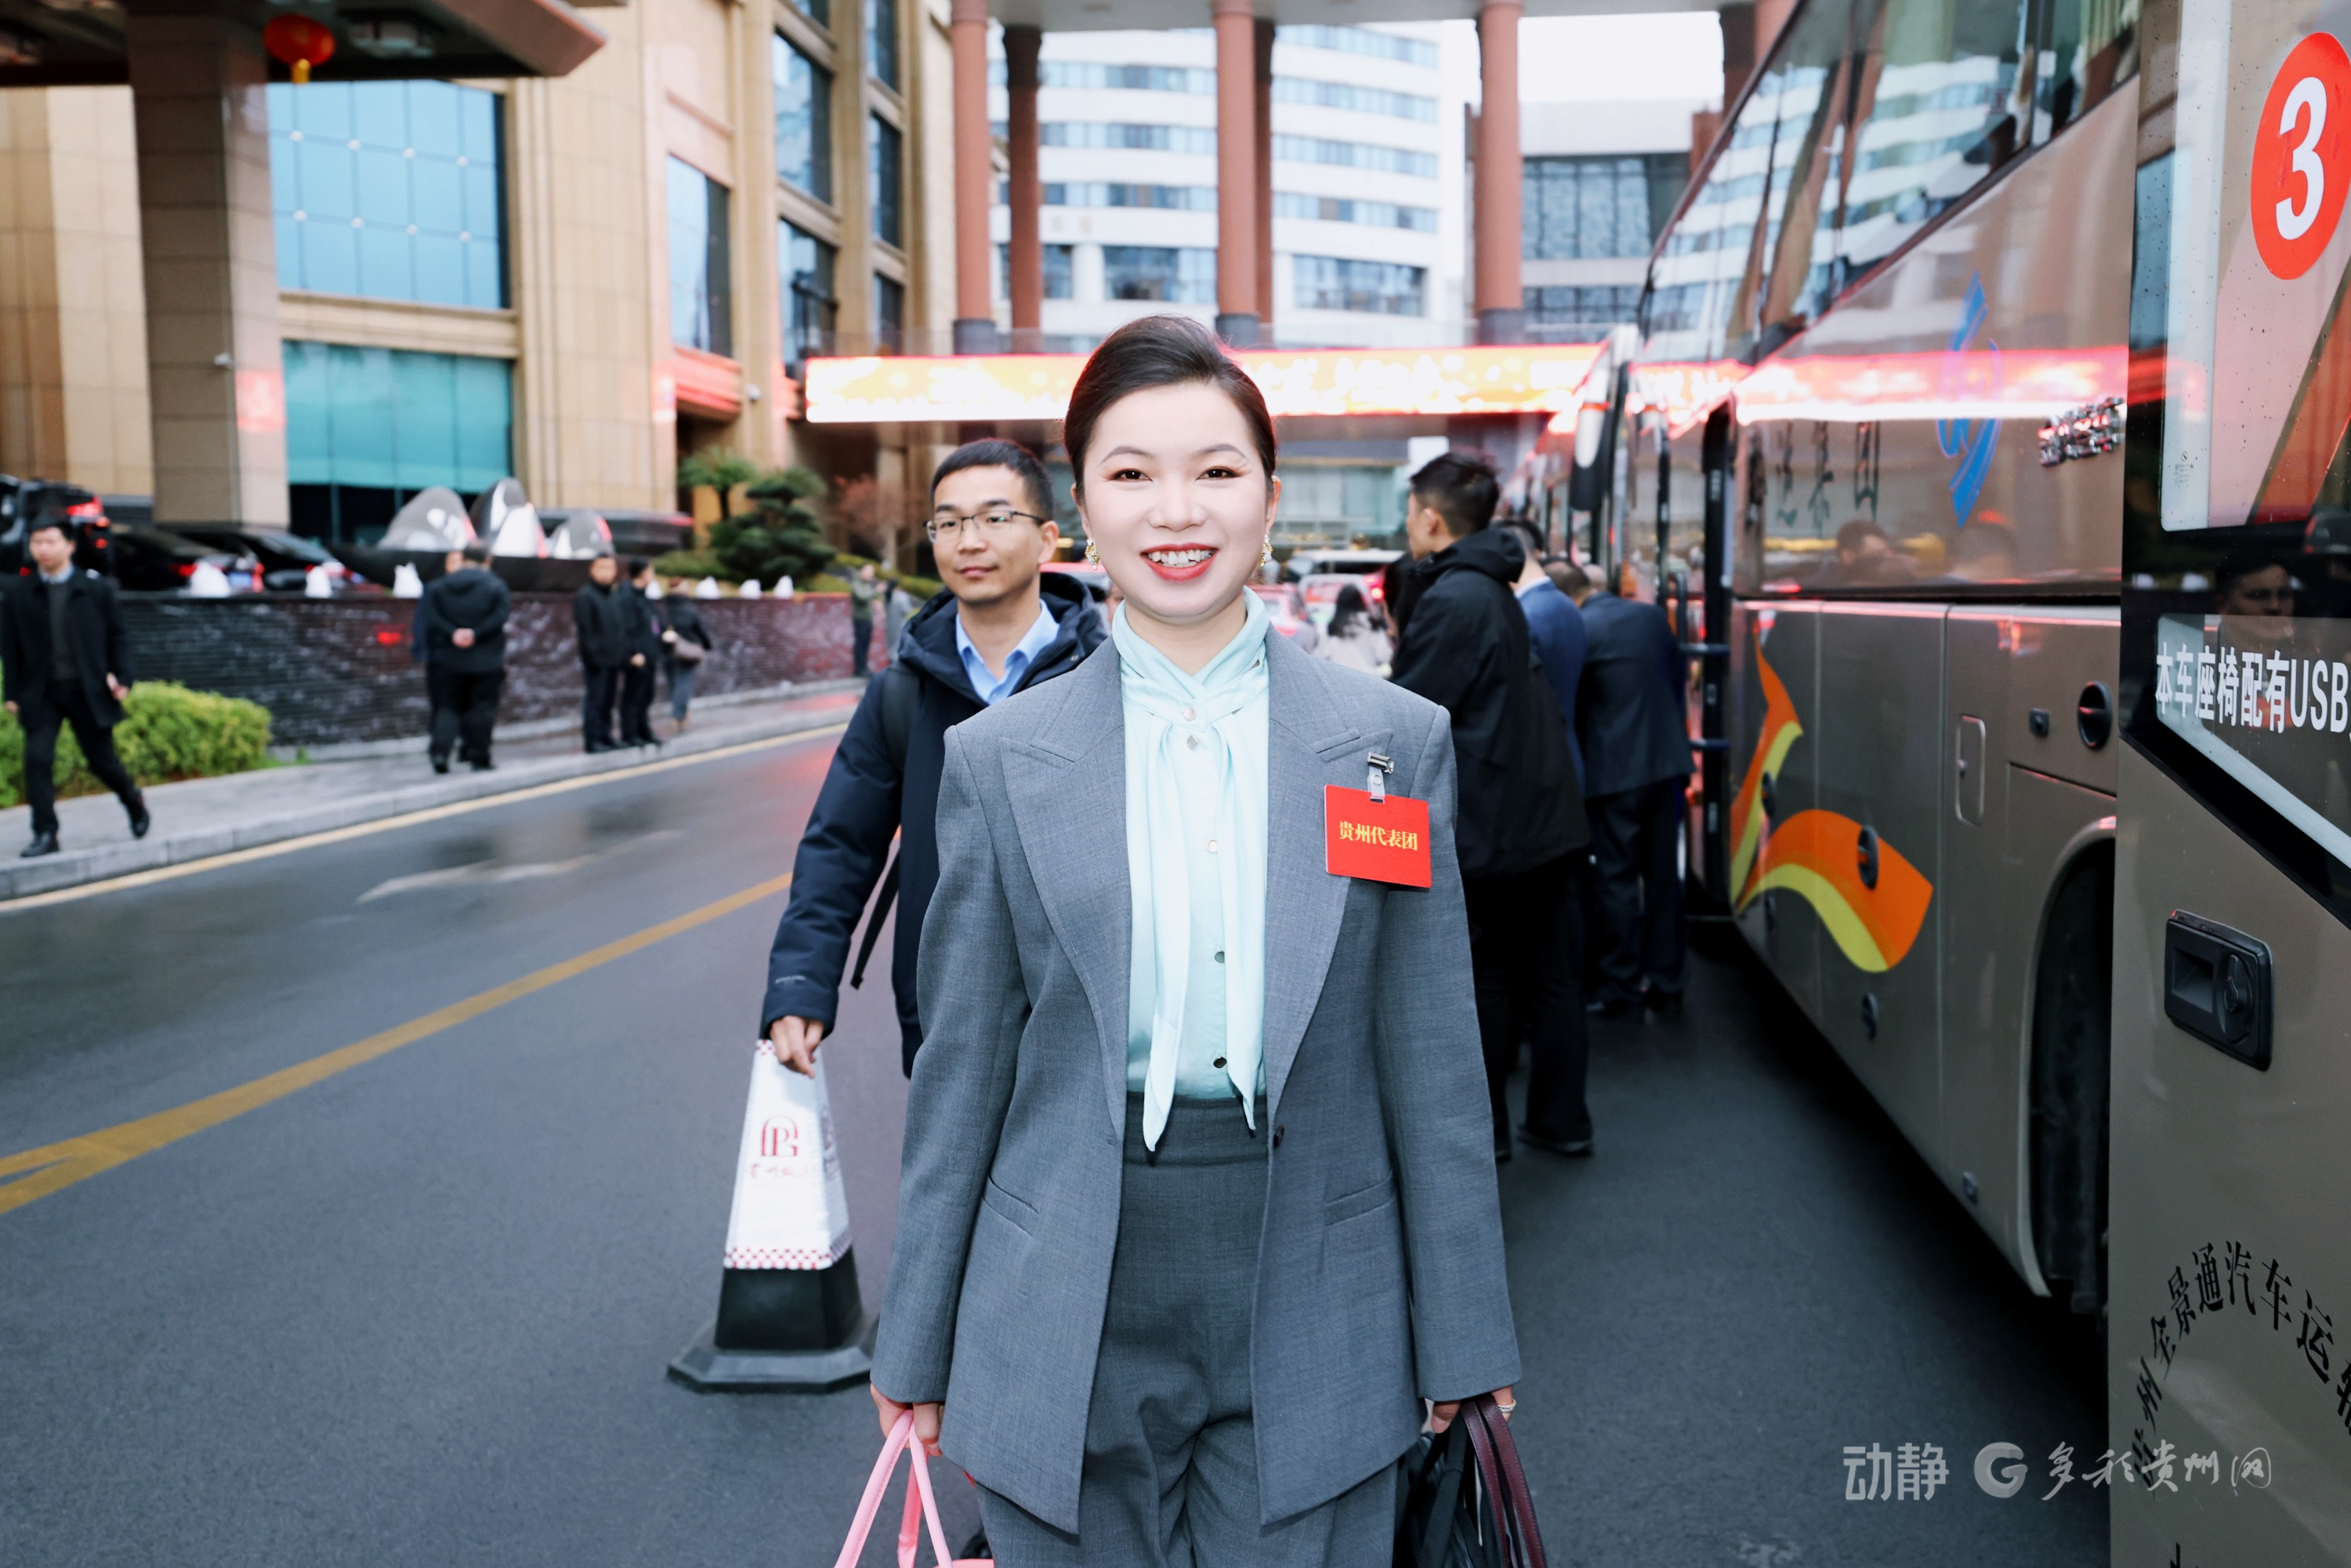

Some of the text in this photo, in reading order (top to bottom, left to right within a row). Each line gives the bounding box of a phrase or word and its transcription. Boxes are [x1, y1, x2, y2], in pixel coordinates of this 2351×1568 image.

[2276, 76, 2327, 241] 3
[2155, 642, 2351, 743] 本车座椅配有USB
[1339, 820, 1418, 851] 贵州代表团
